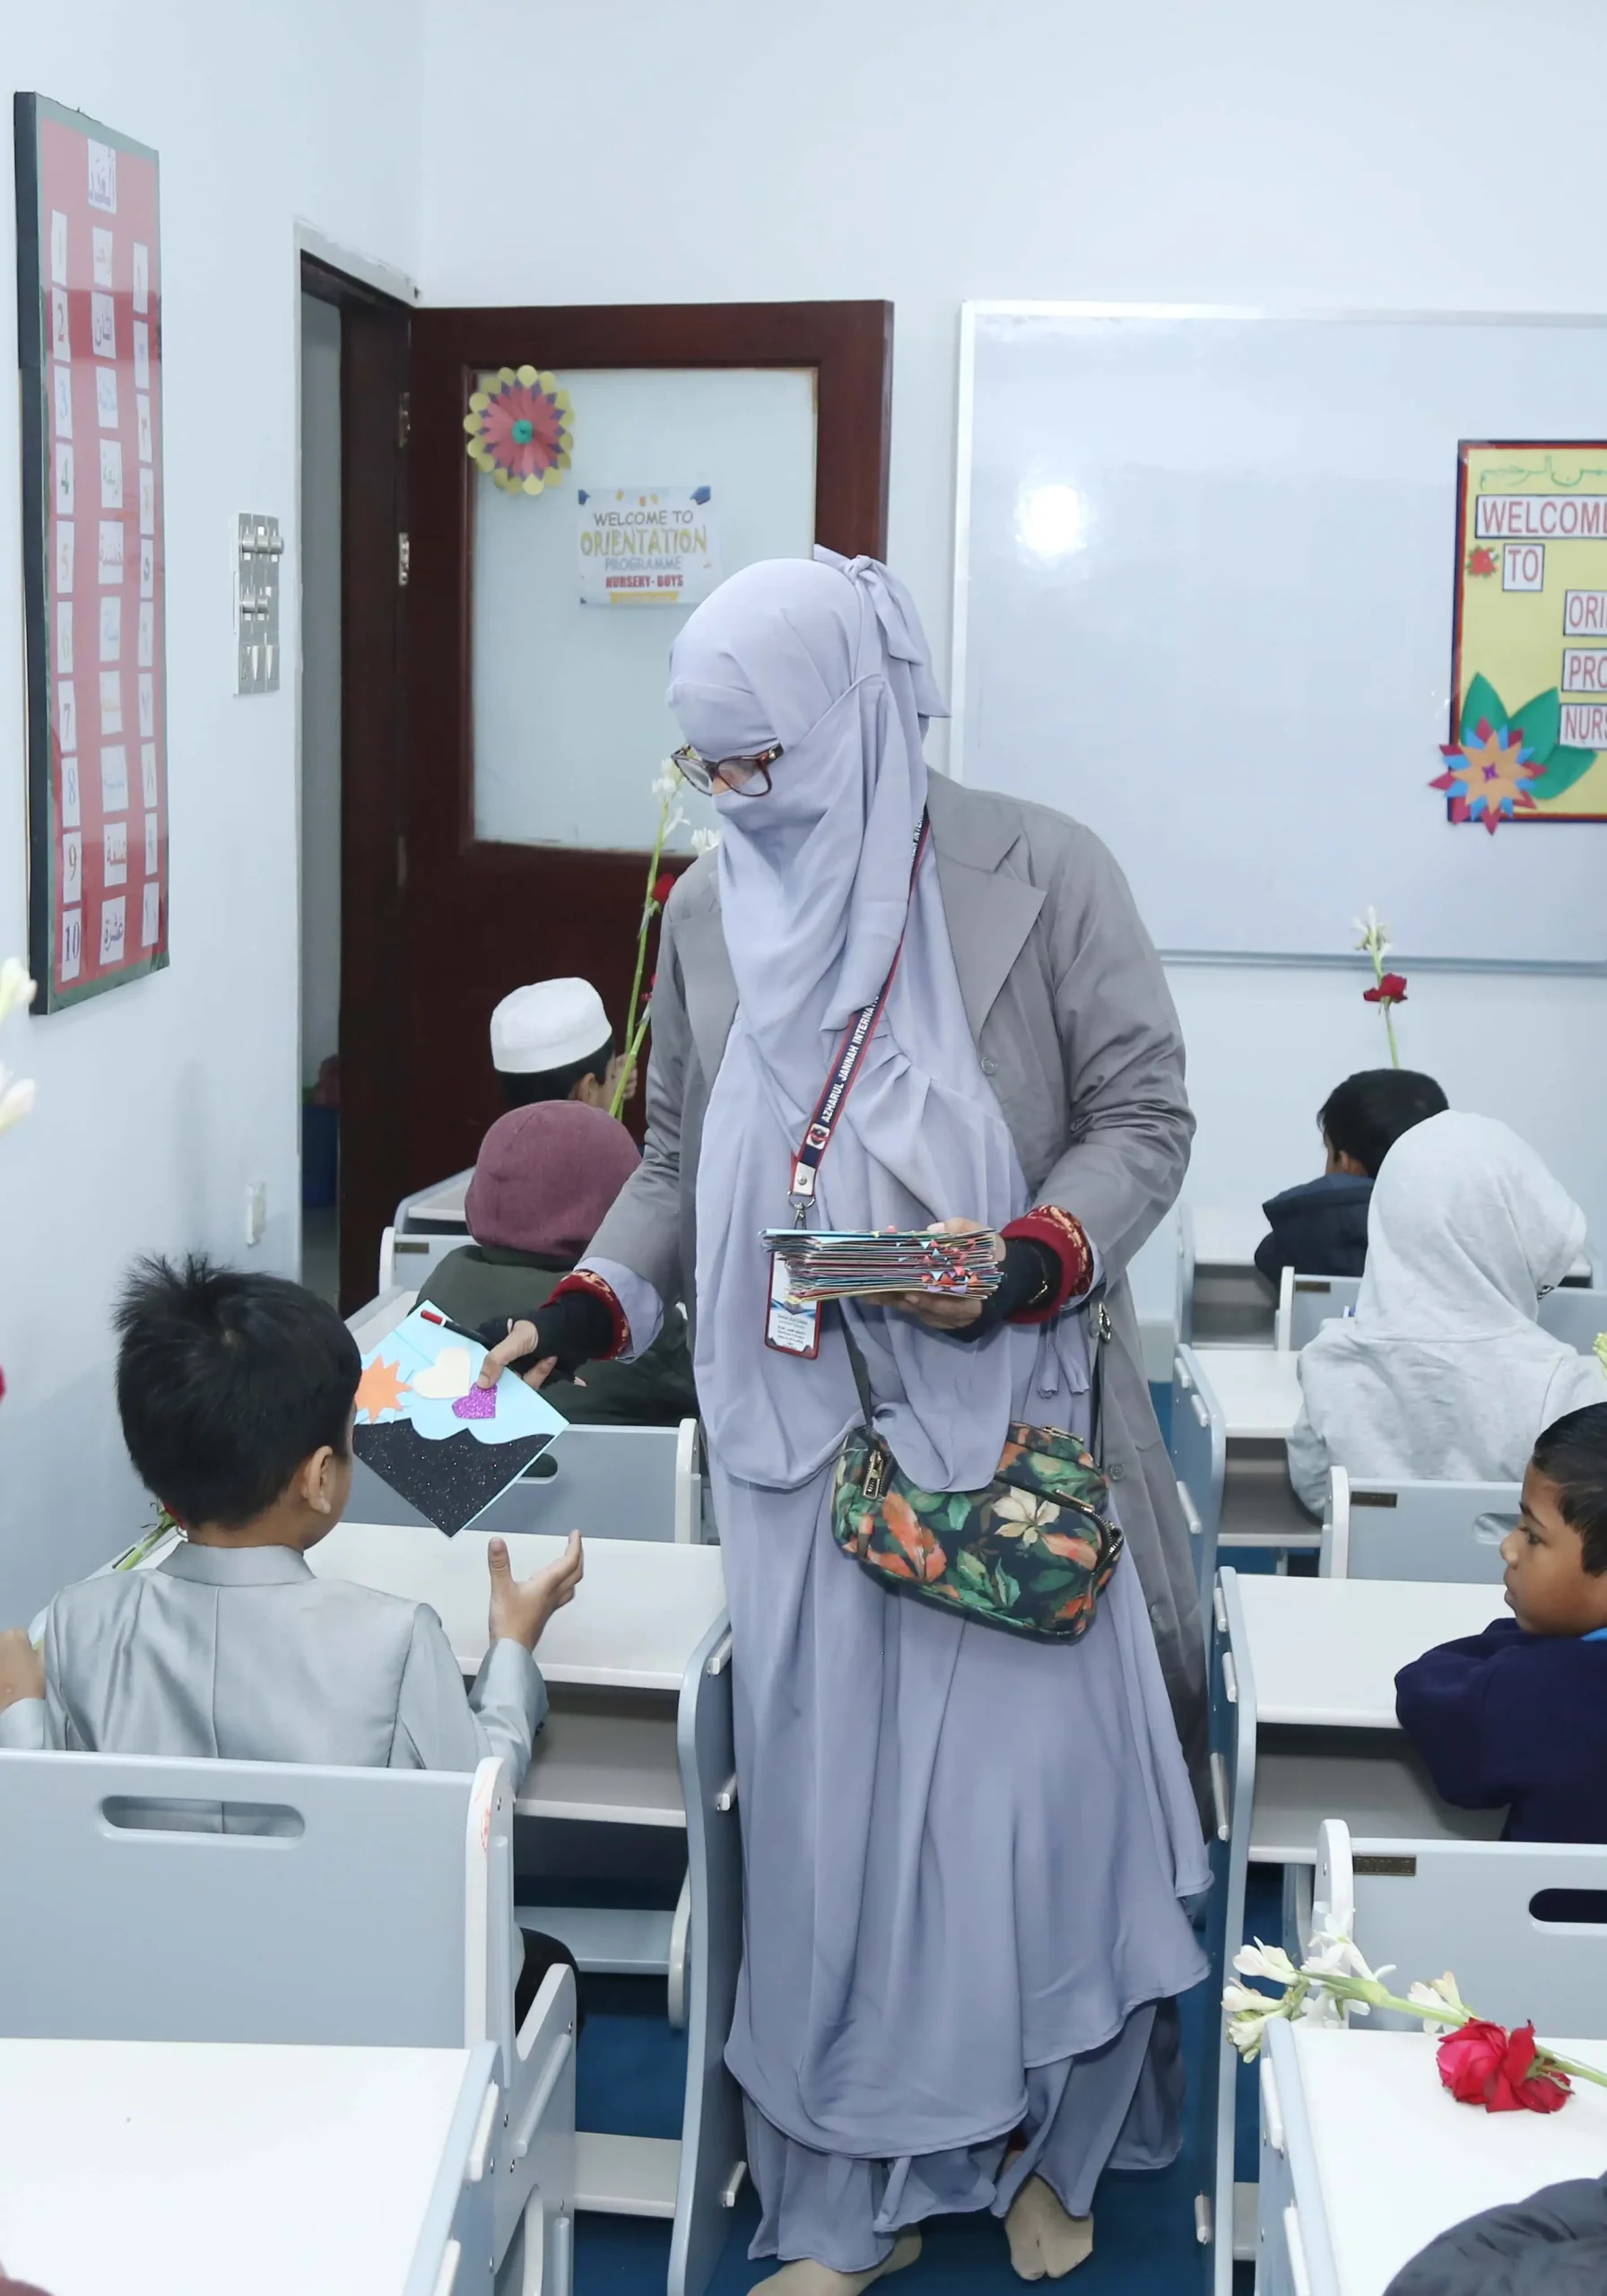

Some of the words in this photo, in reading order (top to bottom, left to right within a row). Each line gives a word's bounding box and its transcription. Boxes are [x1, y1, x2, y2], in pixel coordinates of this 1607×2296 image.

[57, 302, 65, 342] 2
[61, 457, 70, 495] 4
[594, 509, 668, 526] WELCOME
[673, 509, 694, 525] TO
[580, 525, 708, 557] ORIENTATION
[605, 556, 683, 571] PROGRAMME
[656, 574, 684, 588] BOYS
[1507, 547, 1541, 582] TO
[1568, 595, 1607, 629] ORI
[64, 702, 72, 741] 7
[1564, 706, 1607, 741] NUR
[68, 767, 75, 805] 8
[69, 843, 77, 882] 9
[65, 921, 81, 961] 10
[821, 1082, 845, 1124] AZHARUL
[838, 1044, 859, 1083] JANNAH
[852, 994, 880, 1045] INTERNA
